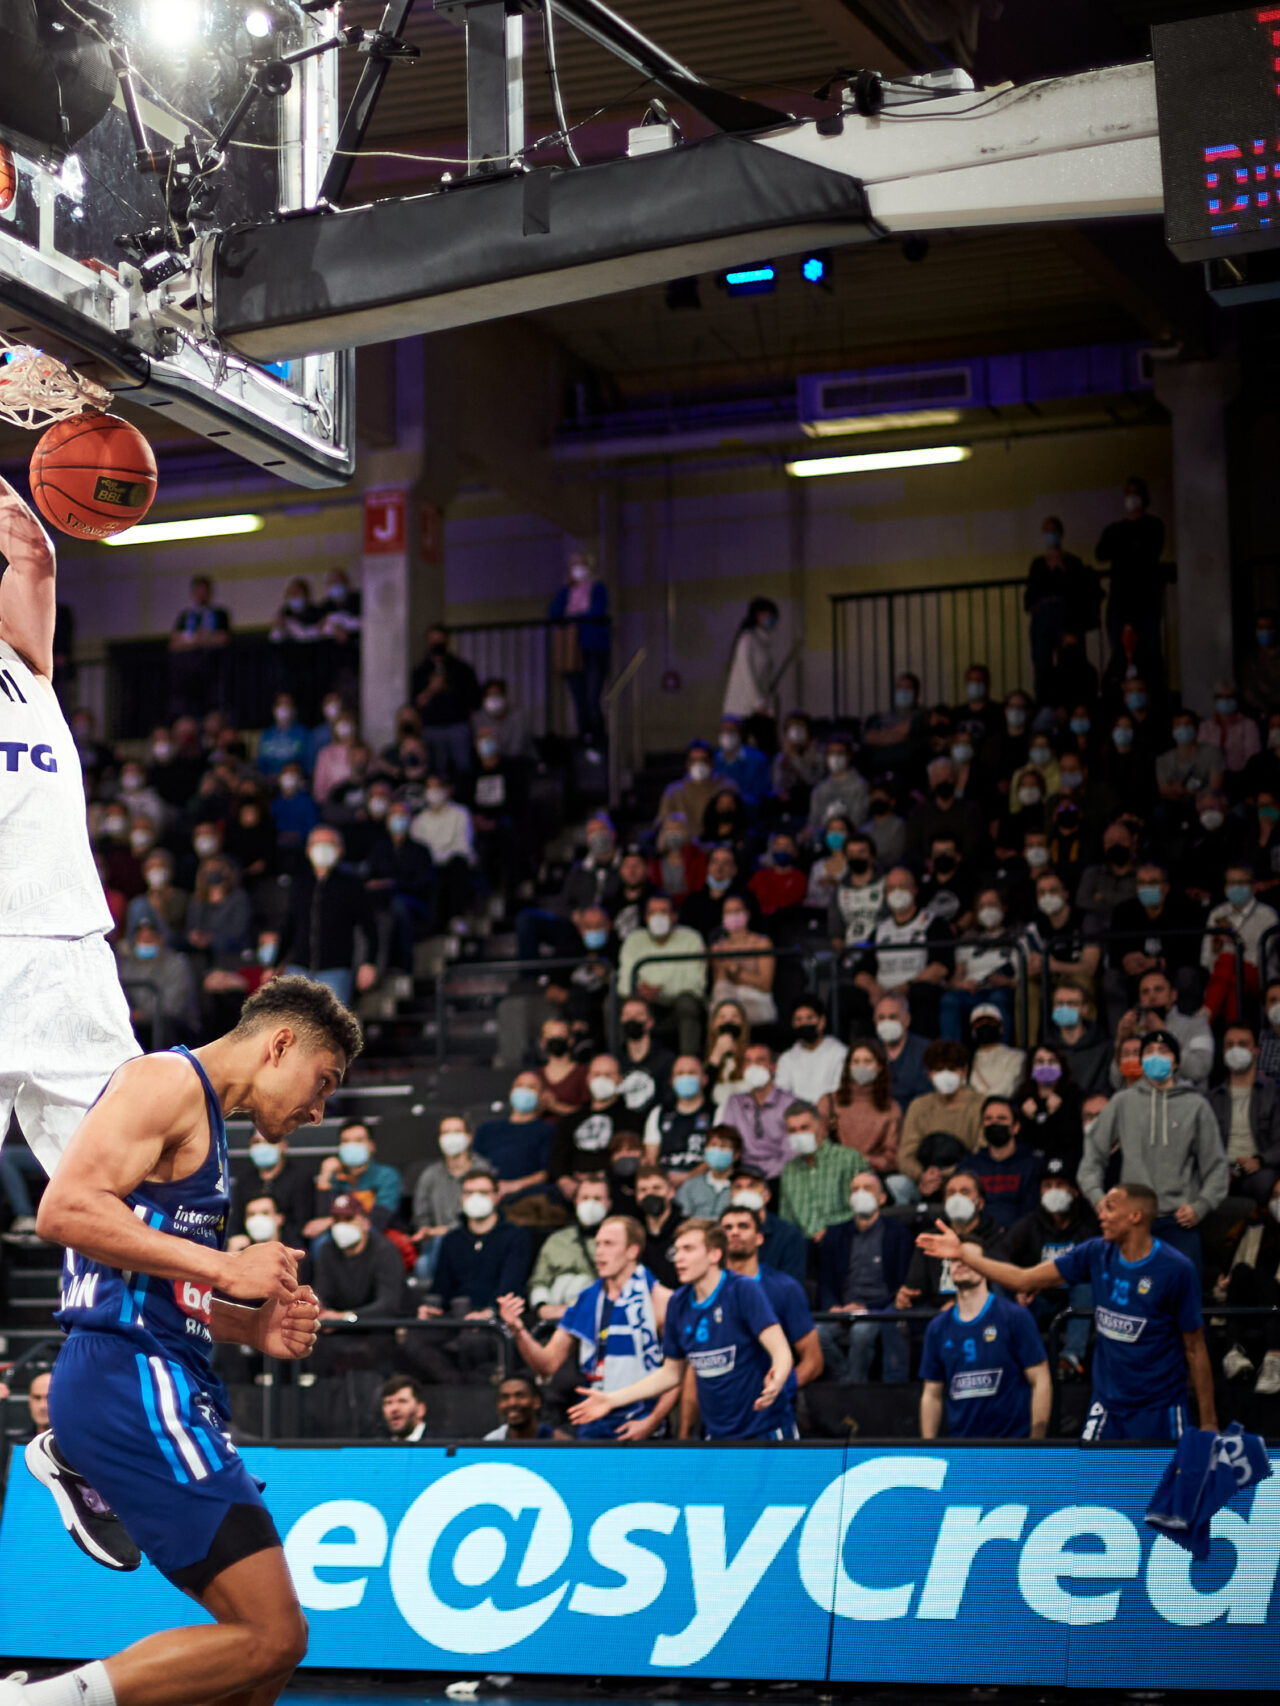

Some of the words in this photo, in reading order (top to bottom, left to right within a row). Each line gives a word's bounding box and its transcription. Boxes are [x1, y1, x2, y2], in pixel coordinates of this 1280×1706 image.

[375, 507, 396, 540] J
[963, 1338, 977, 1362] 9
[281, 1455, 1280, 1668] e@syCred
